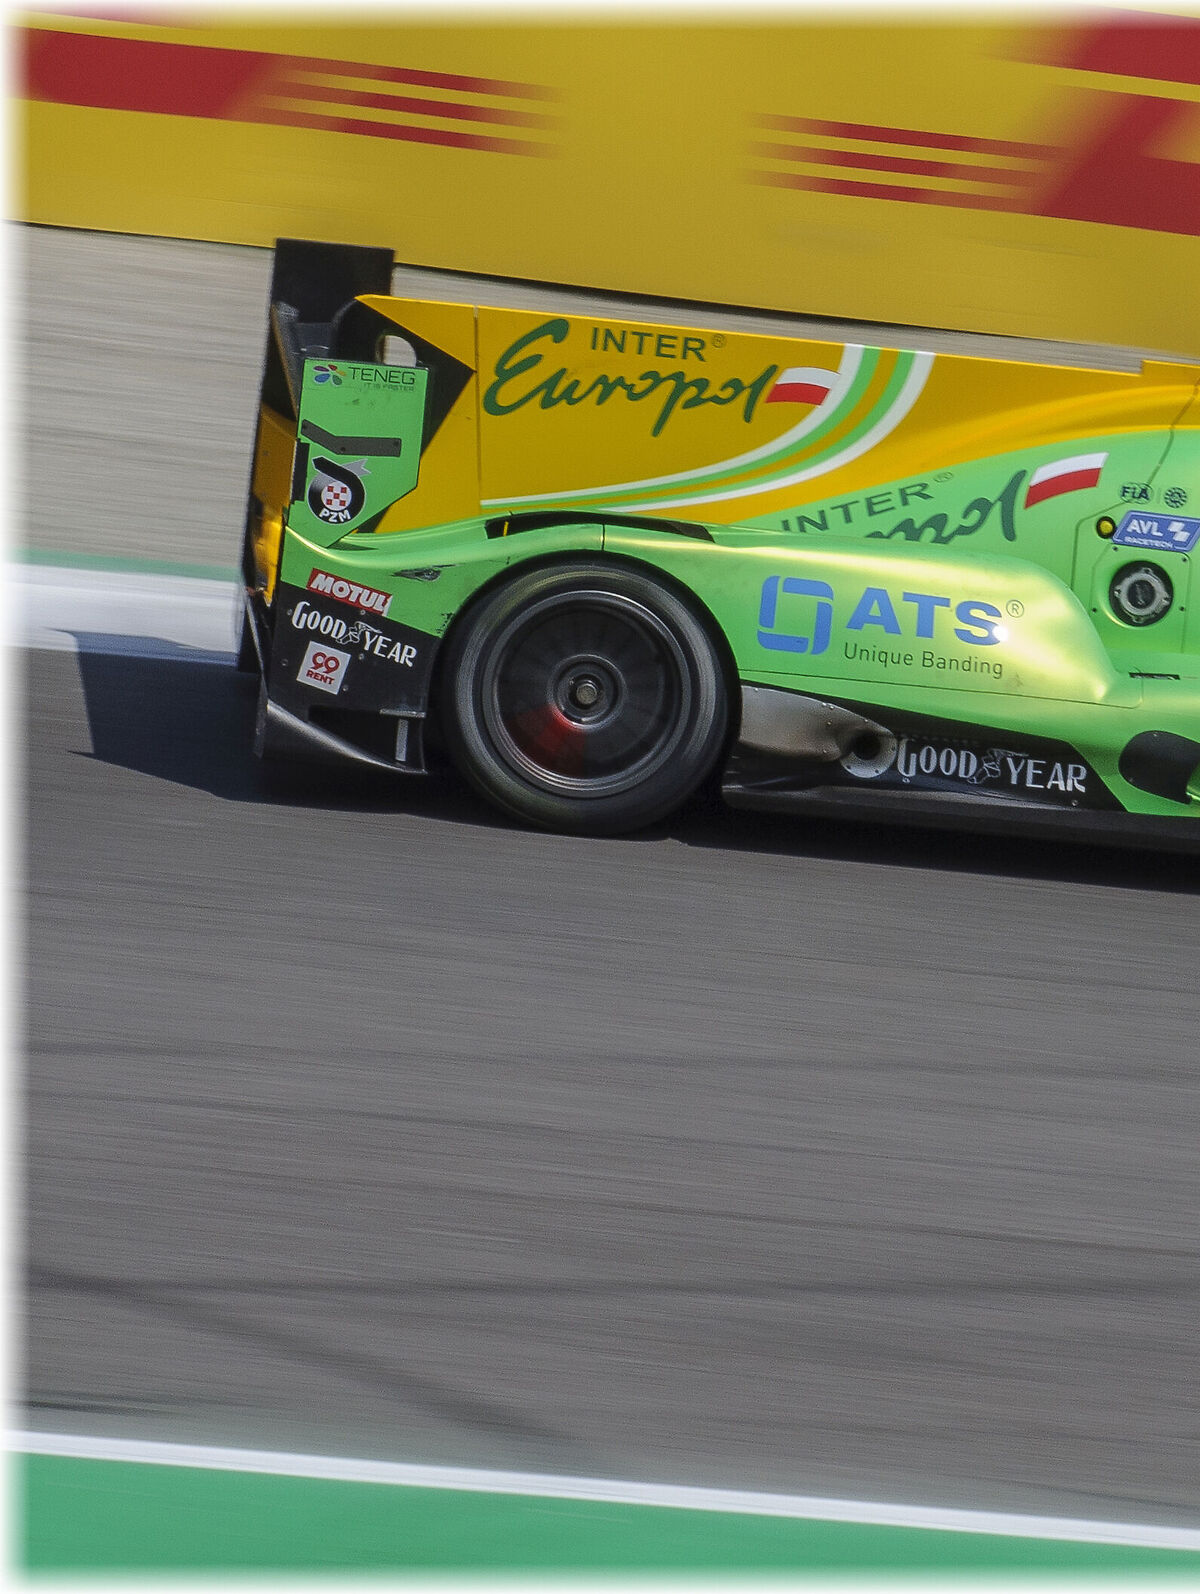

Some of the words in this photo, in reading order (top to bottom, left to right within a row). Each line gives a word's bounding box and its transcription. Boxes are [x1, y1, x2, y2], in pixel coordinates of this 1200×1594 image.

[591, 327, 706, 362] INTER
[348, 366, 416, 385] TENEG
[483, 318, 778, 437] Europol
[781, 481, 935, 533] INTER
[1121, 485, 1150, 501] FIA
[319, 507, 351, 523] PZM
[1126, 519, 1163, 537] AVL
[310, 573, 393, 616] MOTUL
[846, 587, 1003, 646] ATS
[311, 651, 340, 674] 99
[843, 642, 914, 669] Unique
[922, 651, 1003, 679] Banding
[306, 669, 335, 685] RENT
